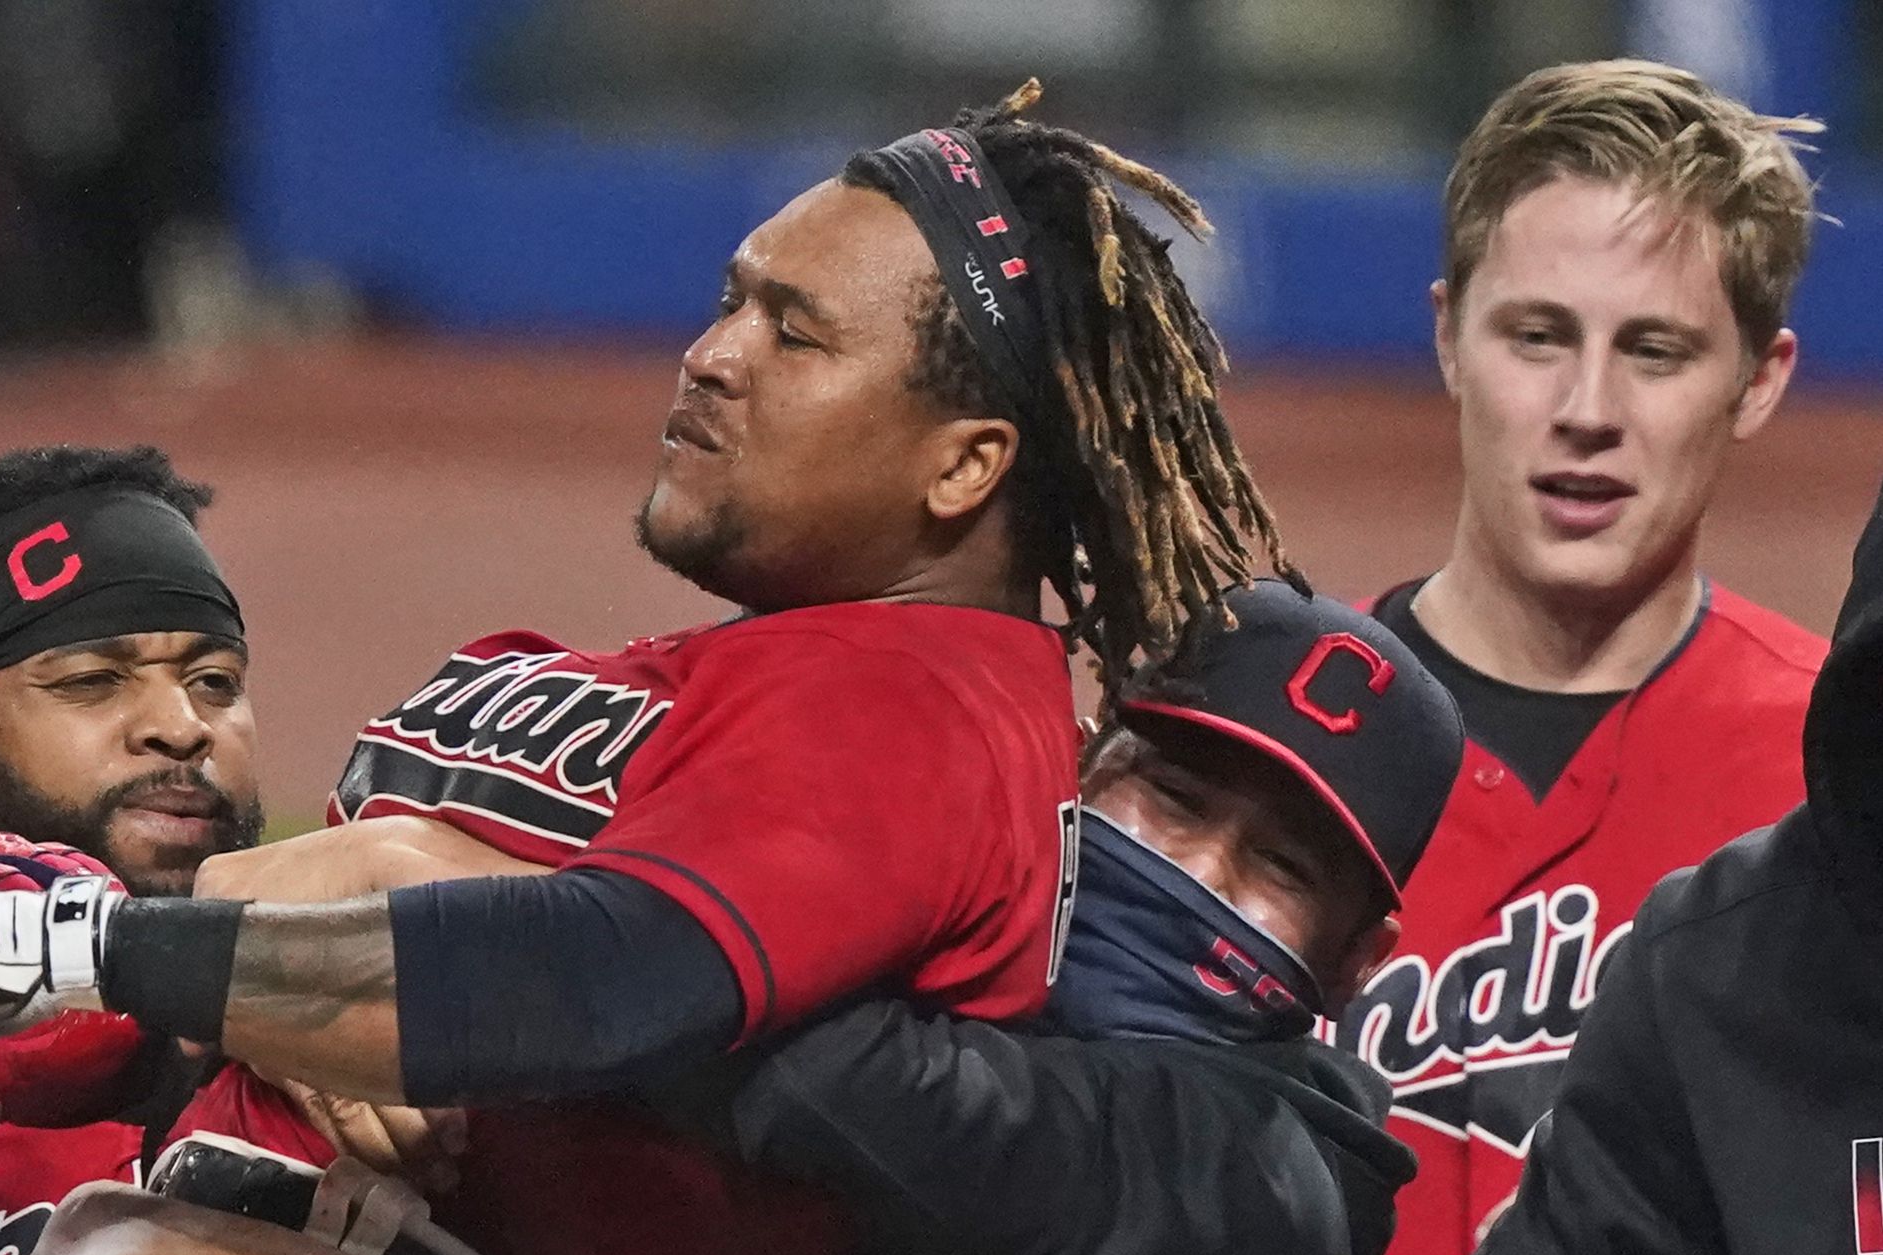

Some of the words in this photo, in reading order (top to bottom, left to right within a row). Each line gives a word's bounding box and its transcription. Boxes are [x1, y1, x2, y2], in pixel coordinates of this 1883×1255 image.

[965, 262, 1005, 326] JUNK
[7, 521, 83, 601] C
[1286, 631, 1397, 734] C
